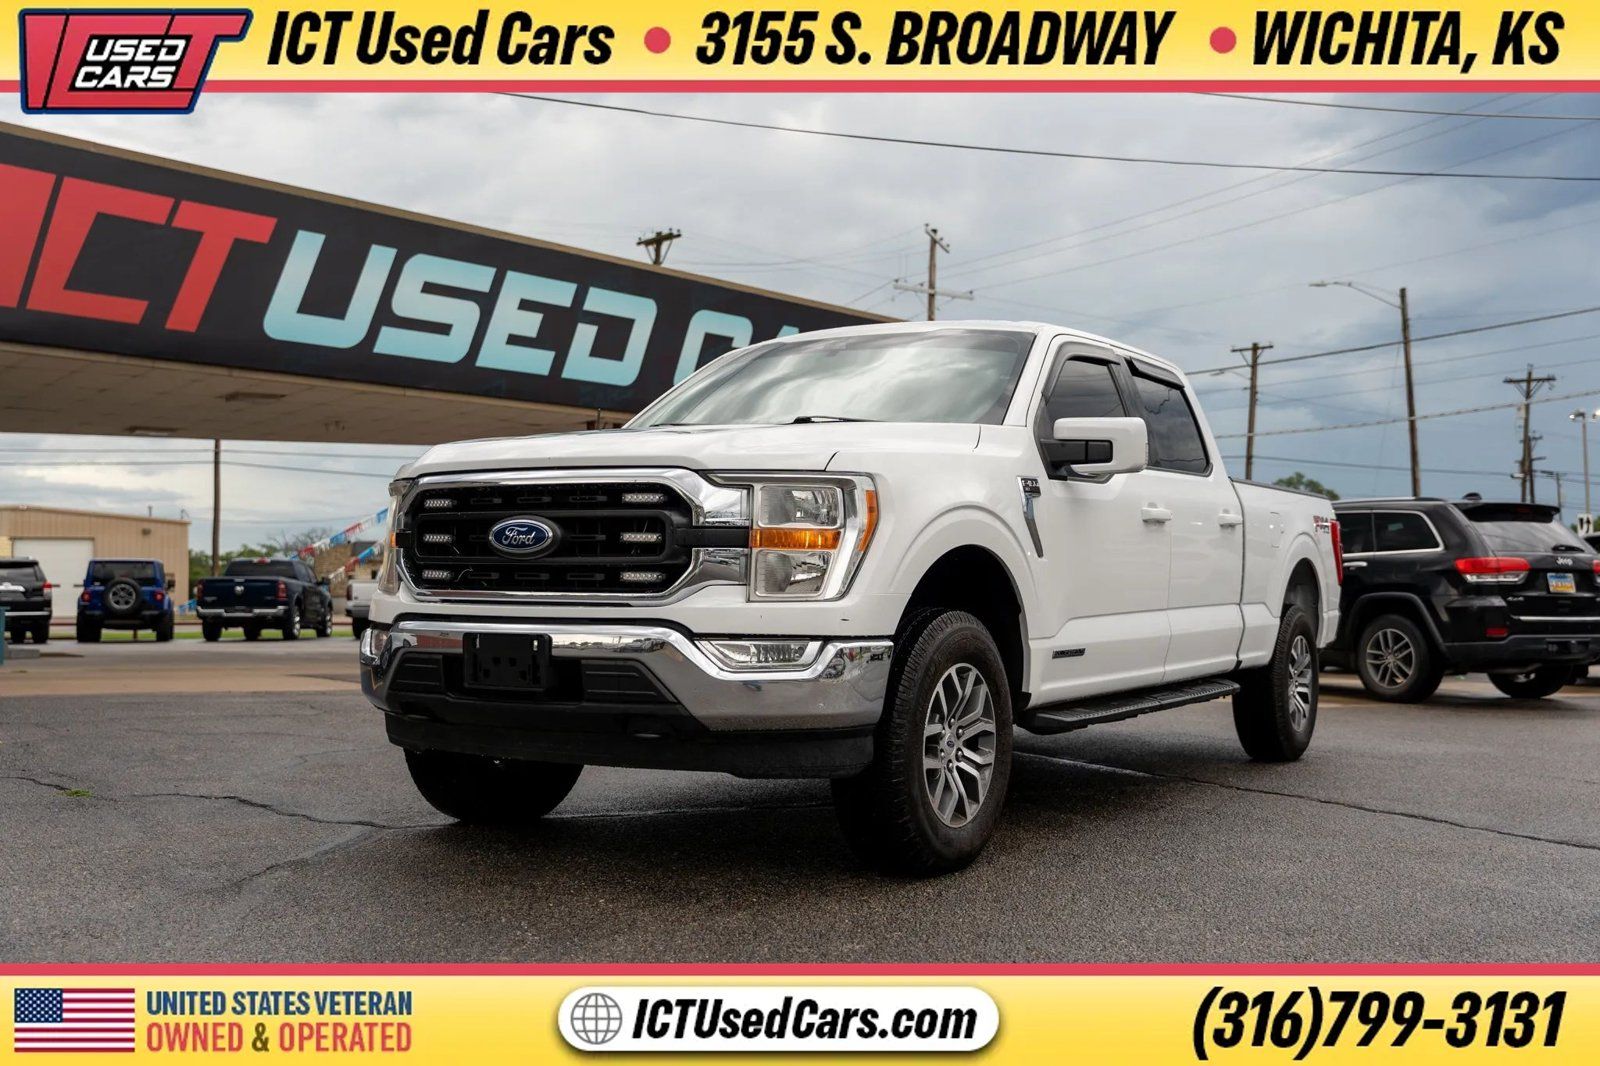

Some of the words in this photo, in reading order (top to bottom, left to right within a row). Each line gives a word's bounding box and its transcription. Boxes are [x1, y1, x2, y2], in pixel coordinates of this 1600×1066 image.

[0, 163, 277, 332] ICT
[263, 229, 657, 387] USED
[502, 526, 536, 545] Ford
